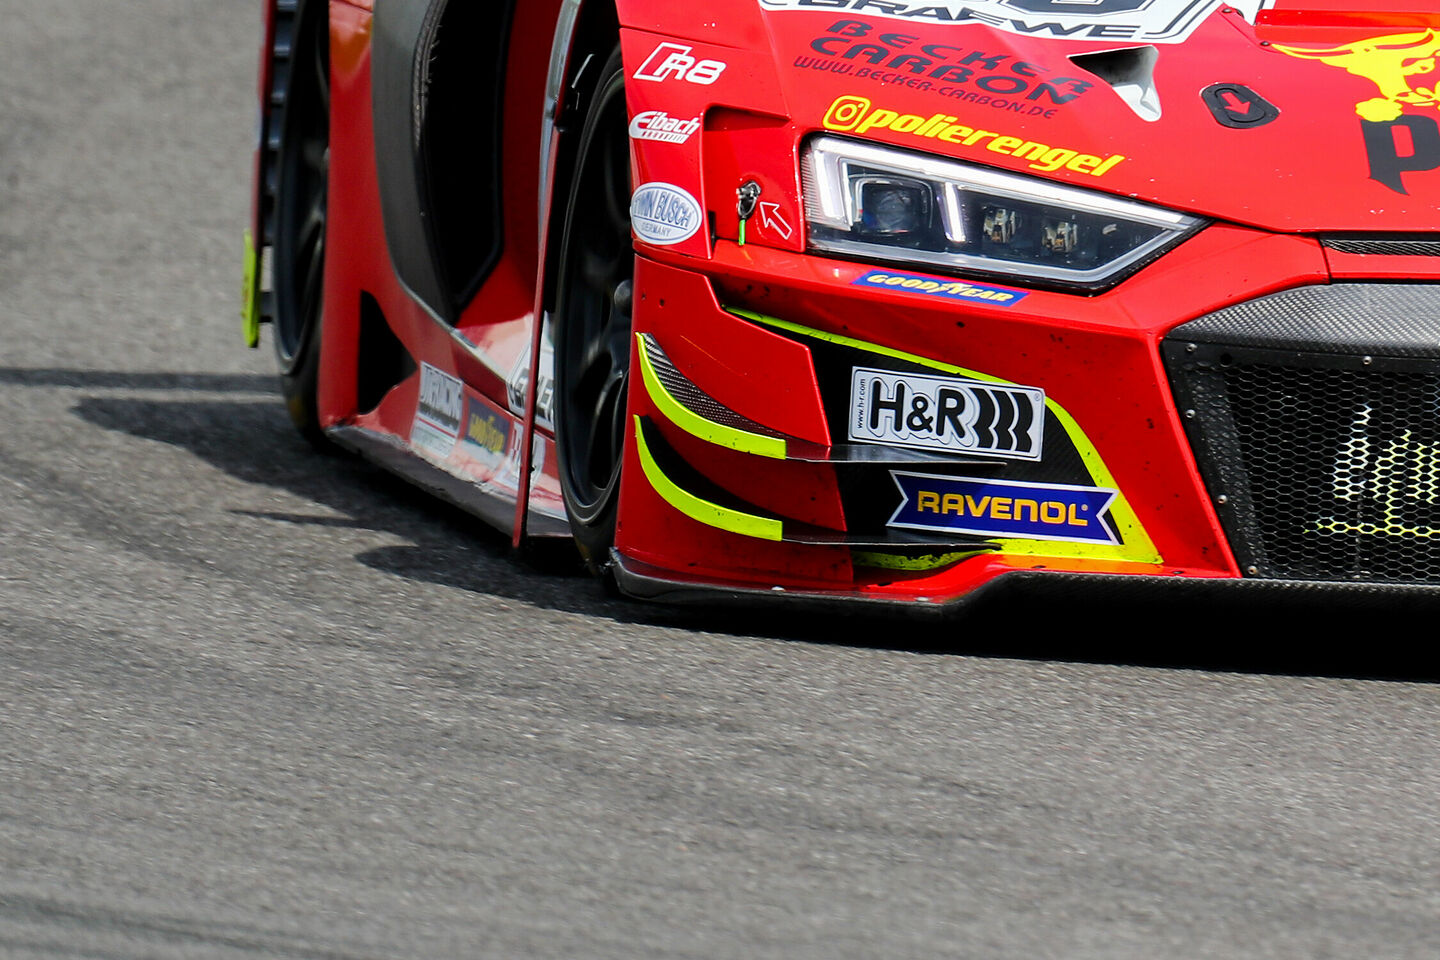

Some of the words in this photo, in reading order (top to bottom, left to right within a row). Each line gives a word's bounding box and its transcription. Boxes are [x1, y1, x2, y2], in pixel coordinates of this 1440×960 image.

[653, 52, 727, 85] R8
[810, 36, 1082, 106] CARBON
[826, 19, 1094, 95] BECKER
[793, 55, 1059, 119] WWW.BECKER-CARBON.DE
[629, 112, 700, 144] Eibach
[855, 108, 1125, 176] polierengel
[655, 191, 692, 228] BUSCH
[866, 273, 1015, 303] GOODYEAR
[856, 378, 866, 429] www.h-r.com
[868, 379, 967, 439] H&R
[917, 490, 1088, 526] RAVENOL
